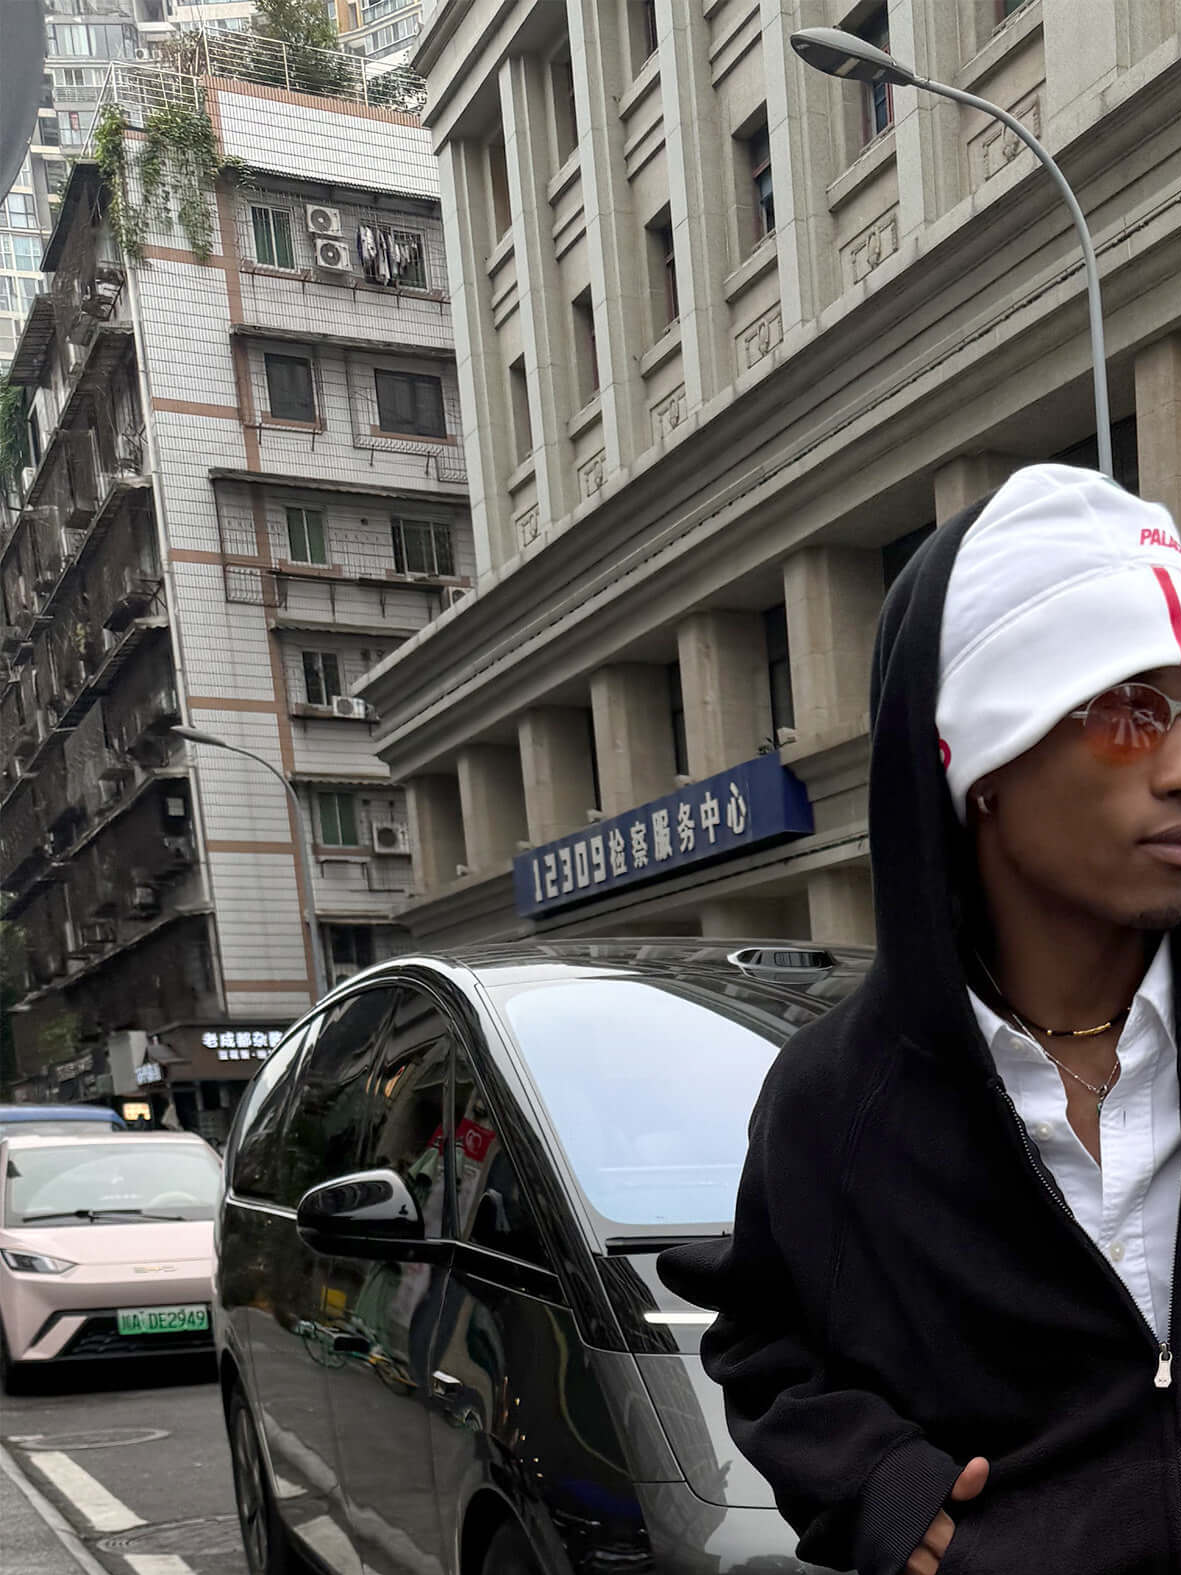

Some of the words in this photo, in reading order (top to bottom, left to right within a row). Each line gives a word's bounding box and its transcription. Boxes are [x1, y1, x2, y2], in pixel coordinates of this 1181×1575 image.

[533, 781, 748, 903] 12309检察服务中心
